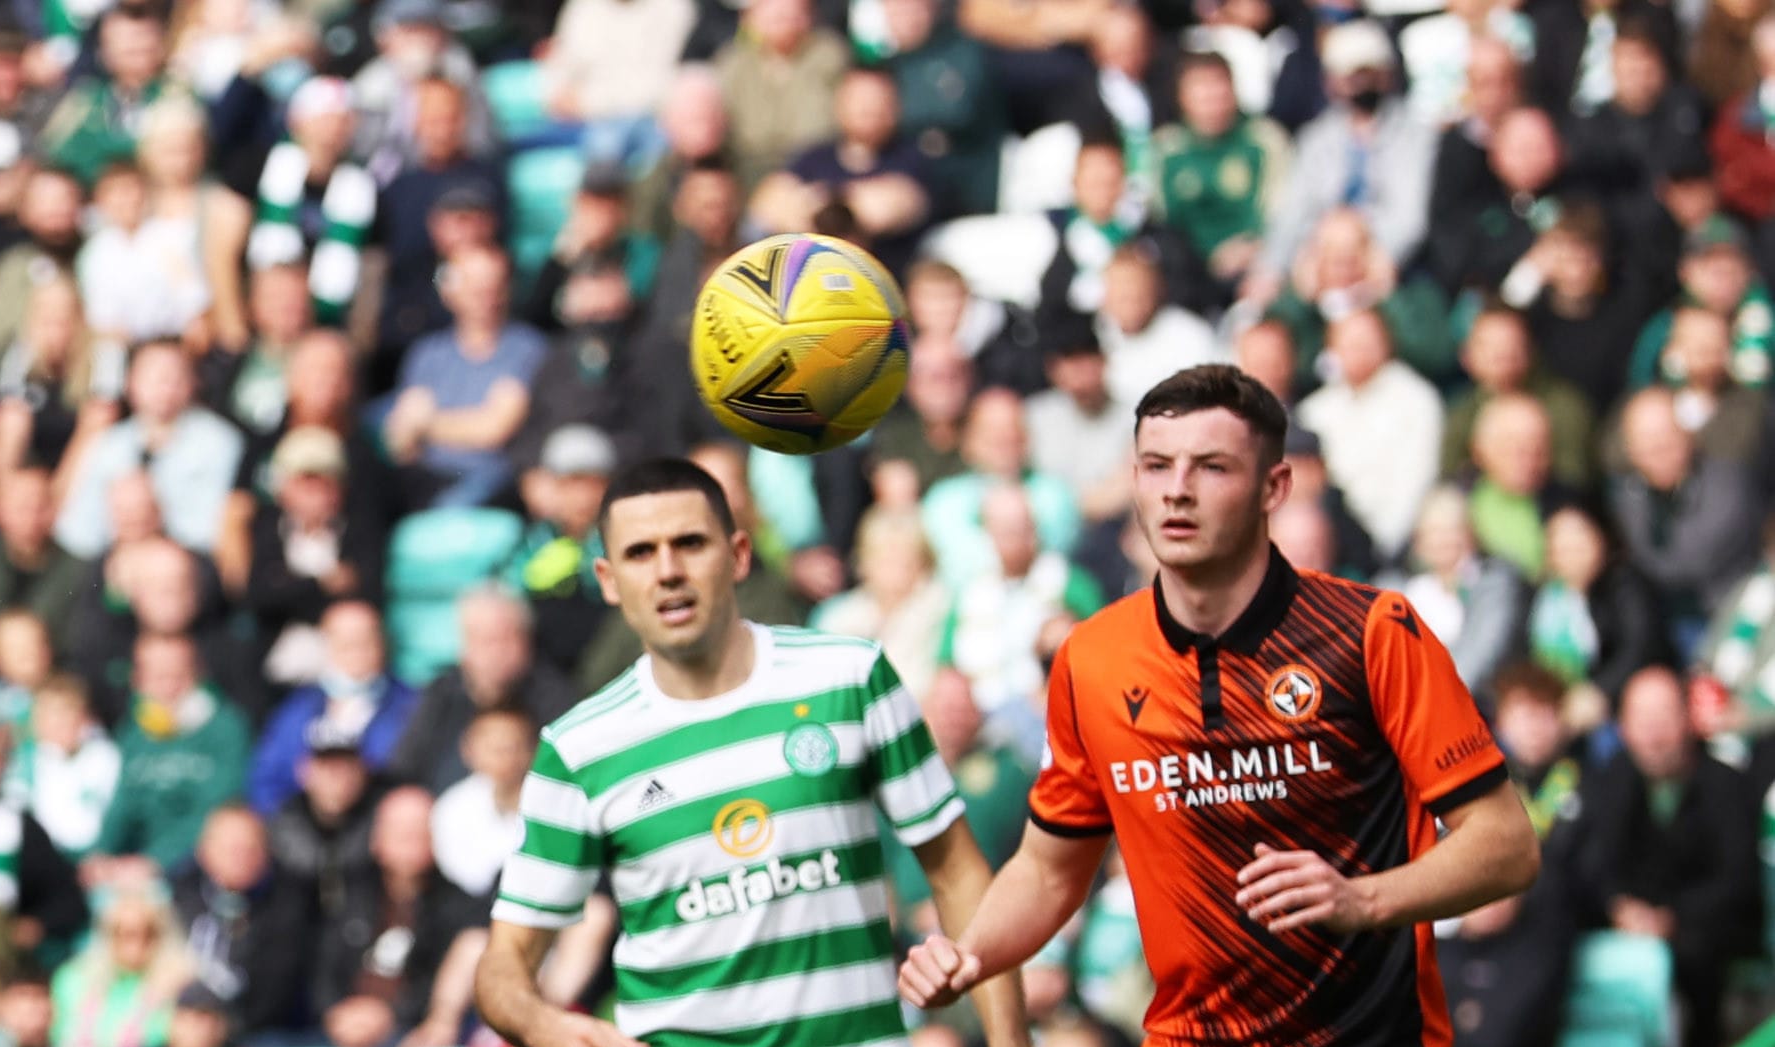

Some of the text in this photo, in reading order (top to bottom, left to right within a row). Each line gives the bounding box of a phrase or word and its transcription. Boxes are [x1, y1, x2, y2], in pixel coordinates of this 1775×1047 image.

[1155, 780, 1289, 812] ST ANDREWS
[675, 849, 842, 923] dafabet
